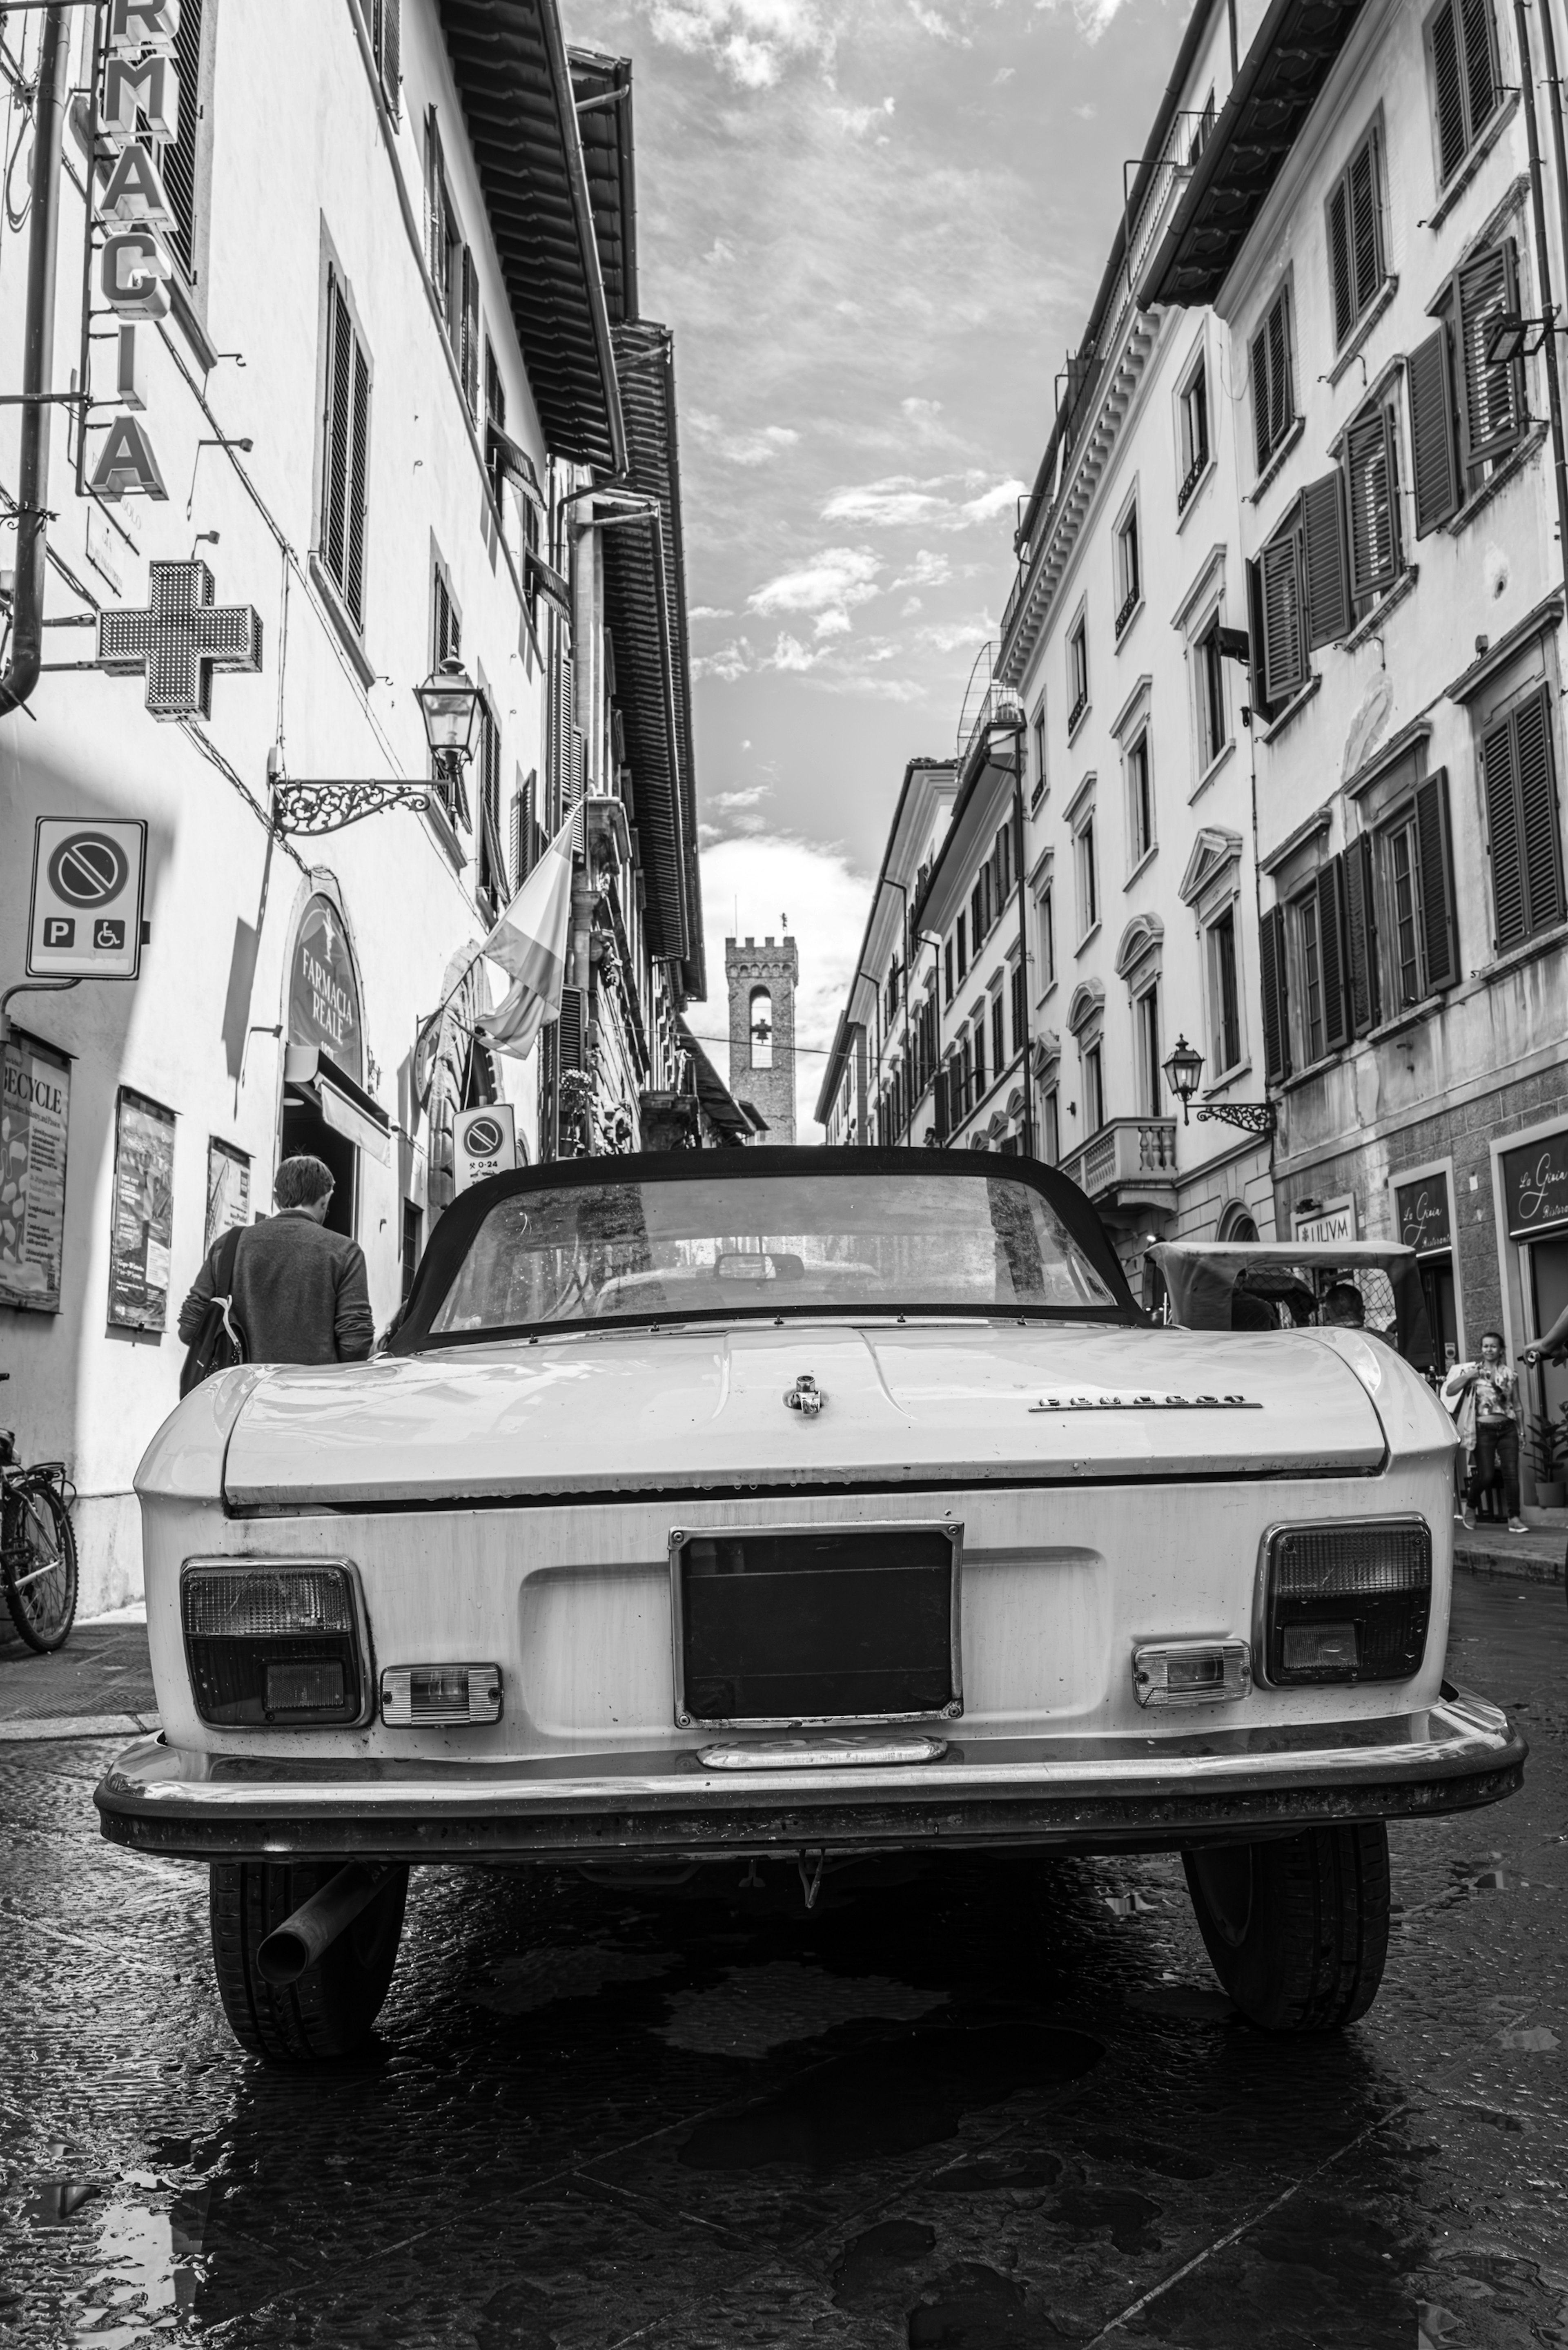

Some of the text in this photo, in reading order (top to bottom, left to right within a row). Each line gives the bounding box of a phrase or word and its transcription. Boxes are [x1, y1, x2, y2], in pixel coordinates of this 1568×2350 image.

[51, 921, 69, 943] P
[303, 947, 353, 1026] FARMACIA
[312, 990, 343, 1047] REALE
[1519, 1153, 1568, 1219] La Gioia
[1403, 1191, 1442, 1247] La Gioia
[1039, 1394, 1246, 1407] PEUGEOT
